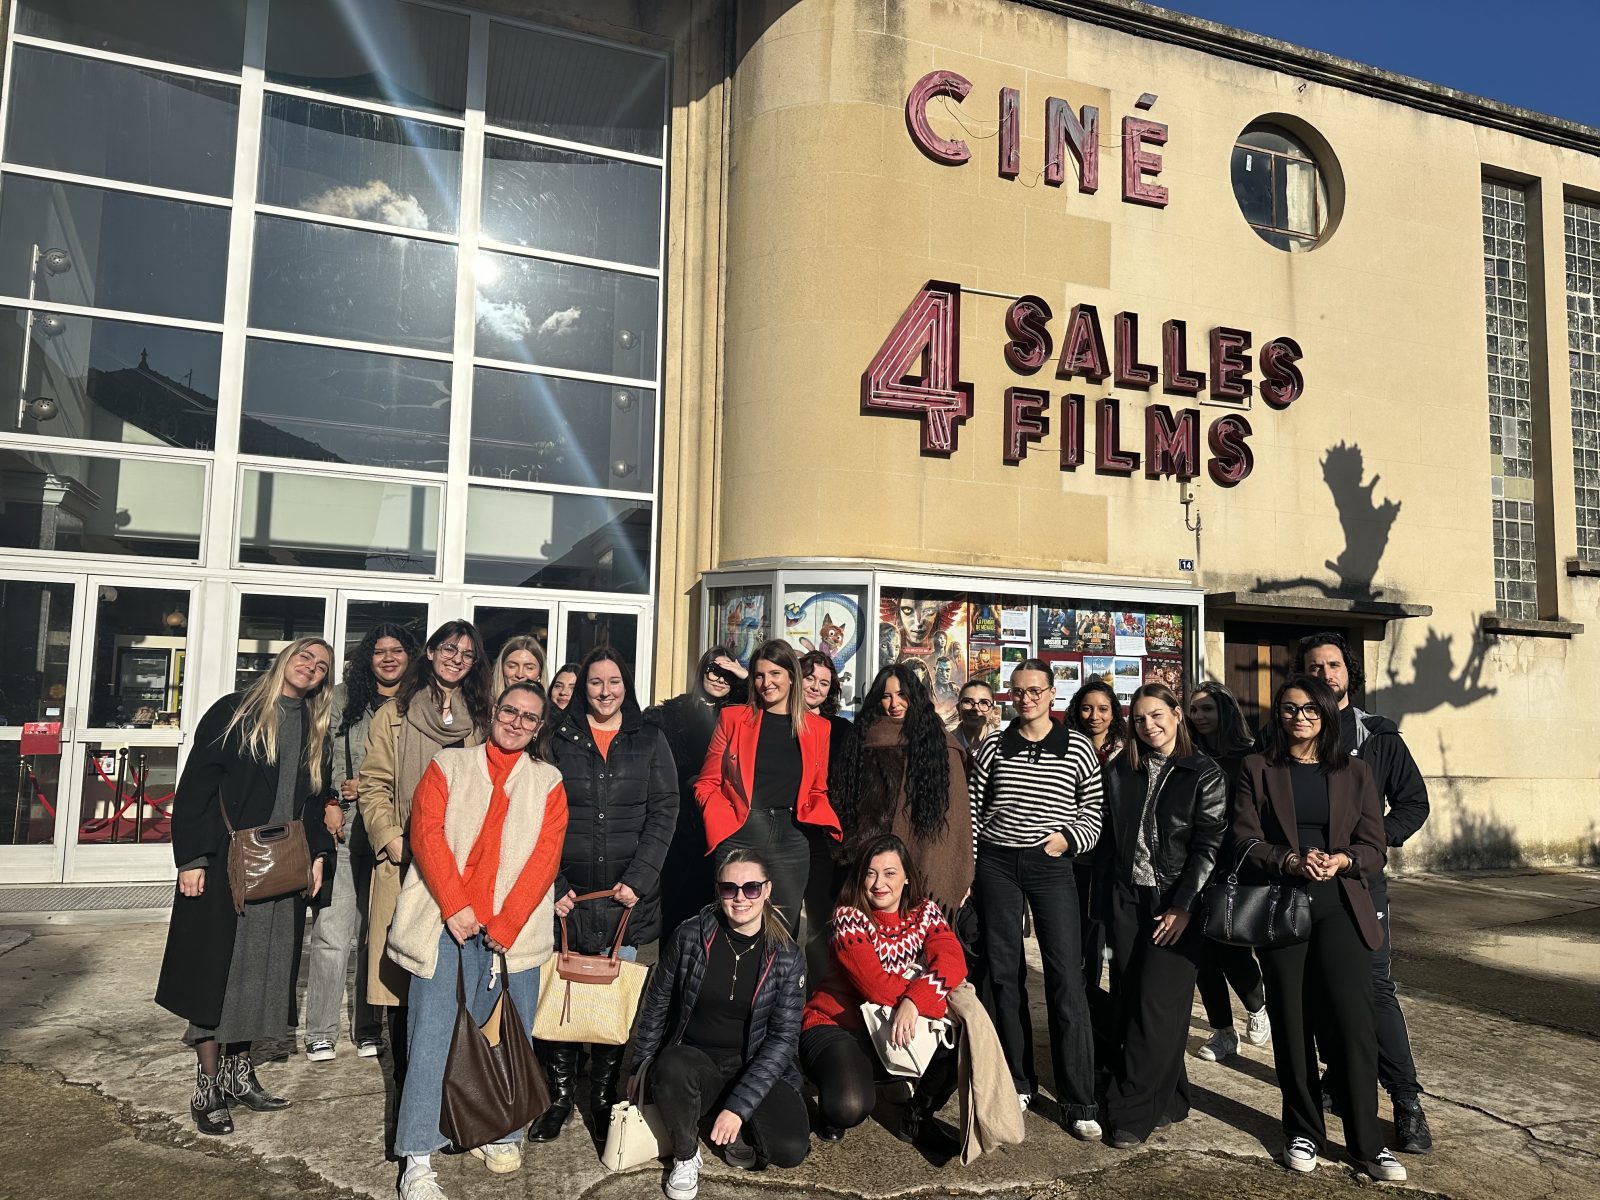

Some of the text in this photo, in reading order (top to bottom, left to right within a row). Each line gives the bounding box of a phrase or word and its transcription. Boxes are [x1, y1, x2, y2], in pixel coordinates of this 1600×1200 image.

[906, 70, 1169, 209] CINÉ
[860, 278, 1304, 457] 4 SALLES
[1003, 386, 1254, 488] FILMS
[1182, 561, 1191, 570] 14
